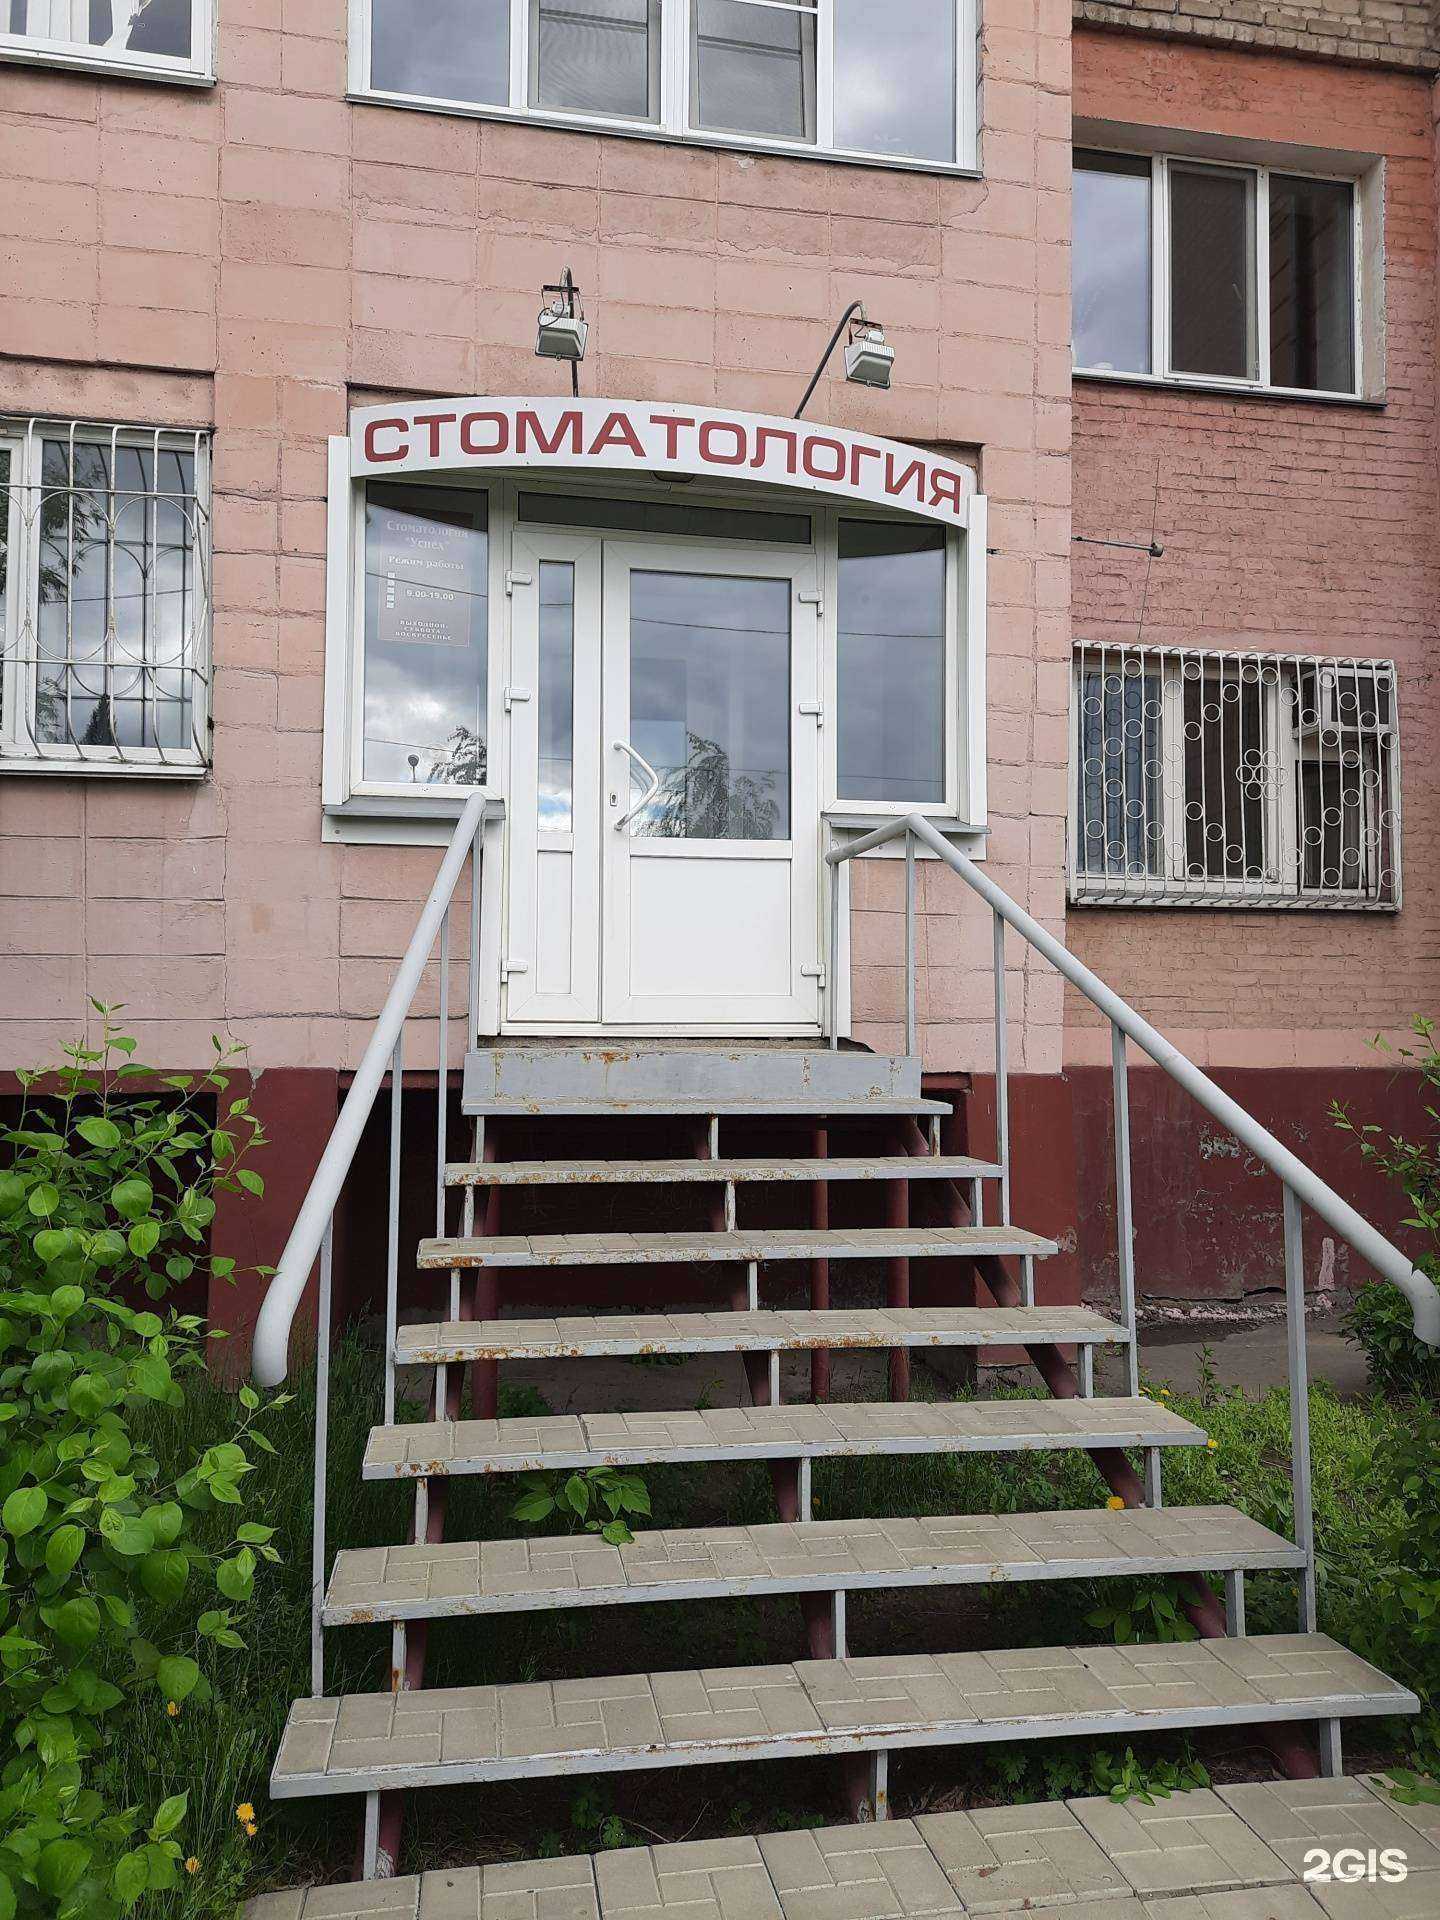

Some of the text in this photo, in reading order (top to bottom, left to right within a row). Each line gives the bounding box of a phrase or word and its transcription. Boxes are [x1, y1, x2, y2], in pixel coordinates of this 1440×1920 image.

[364, 411, 962, 514] СТОМАТОЛОГИЯ
[388, 555, 465, 570] Режим работы
